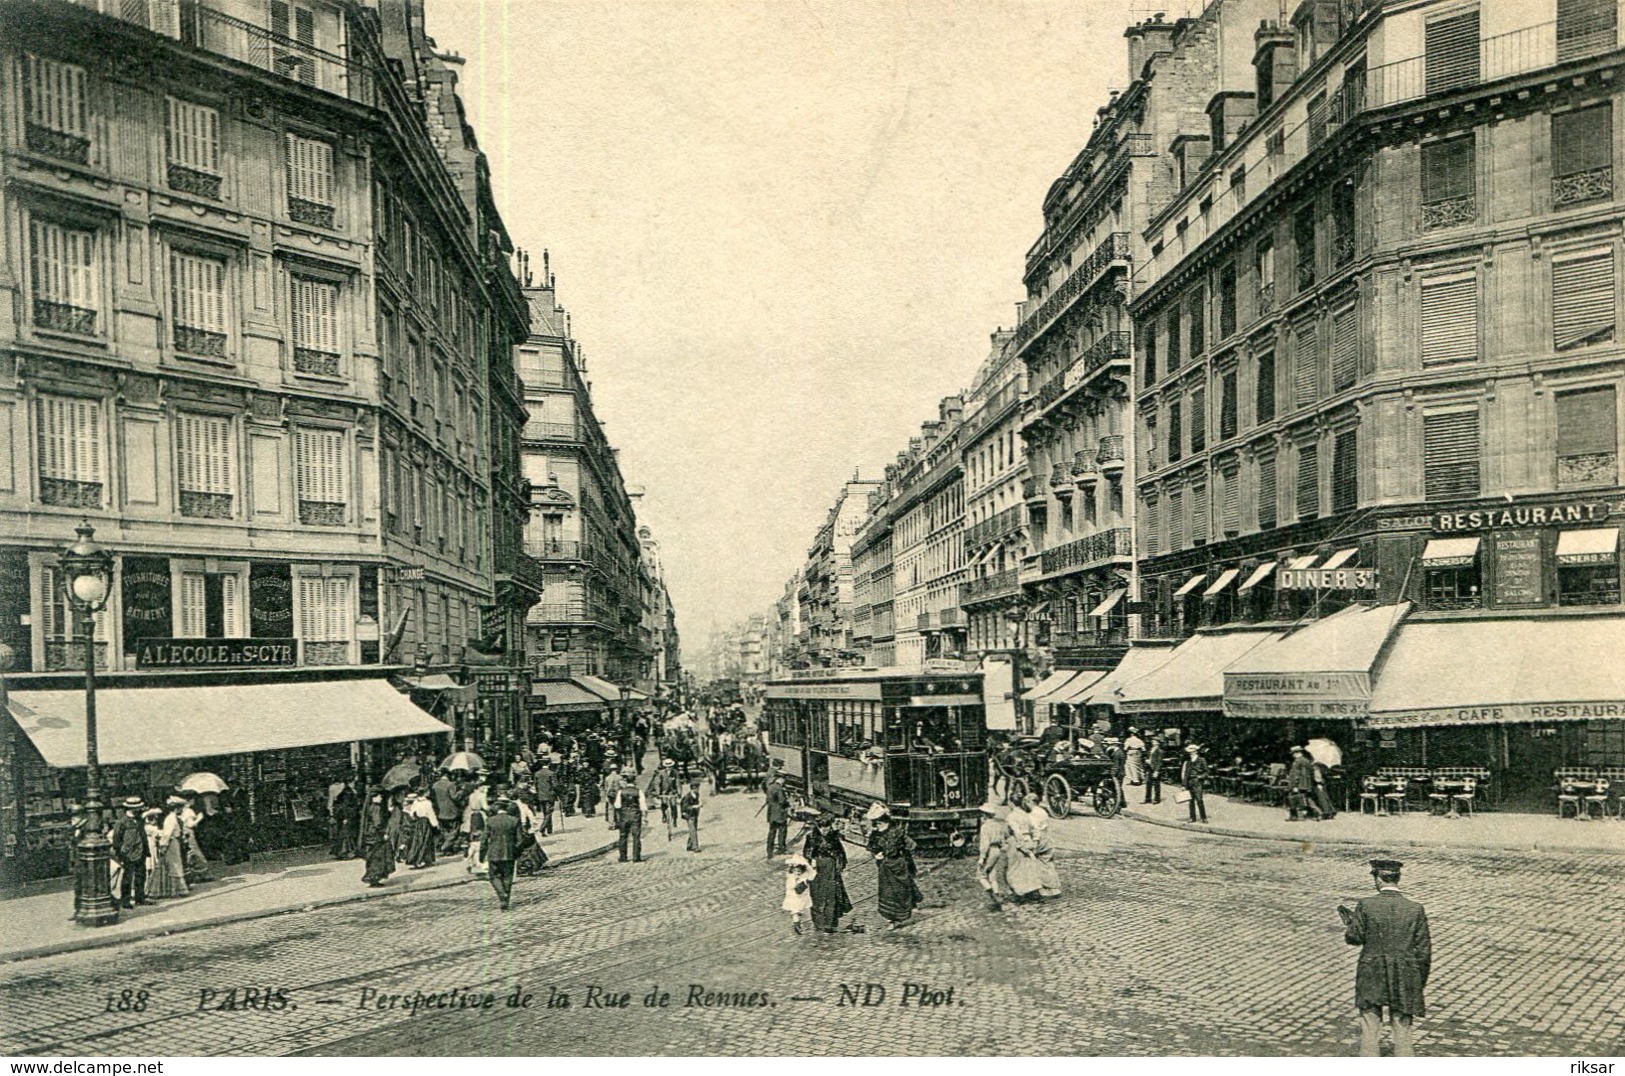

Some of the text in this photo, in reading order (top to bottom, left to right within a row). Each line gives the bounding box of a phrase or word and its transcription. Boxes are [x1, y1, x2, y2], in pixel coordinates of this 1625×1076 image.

[1440, 503, 1598, 530] RESTAURANT
[1496, 539, 1539, 550] RESTAURANT
[123, 571, 170, 588] FOURNITURES
[400, 568, 425, 581] CHANGE
[1281, 571, 1348, 588] DINER
[141, 646, 157, 664] A
[259, 645, 292, 662] CYR
[1236, 679, 1304, 691] RESTAURANT
[1307, 681, 1320, 690] AU
[1458, 708, 1504, 721] CAFE
